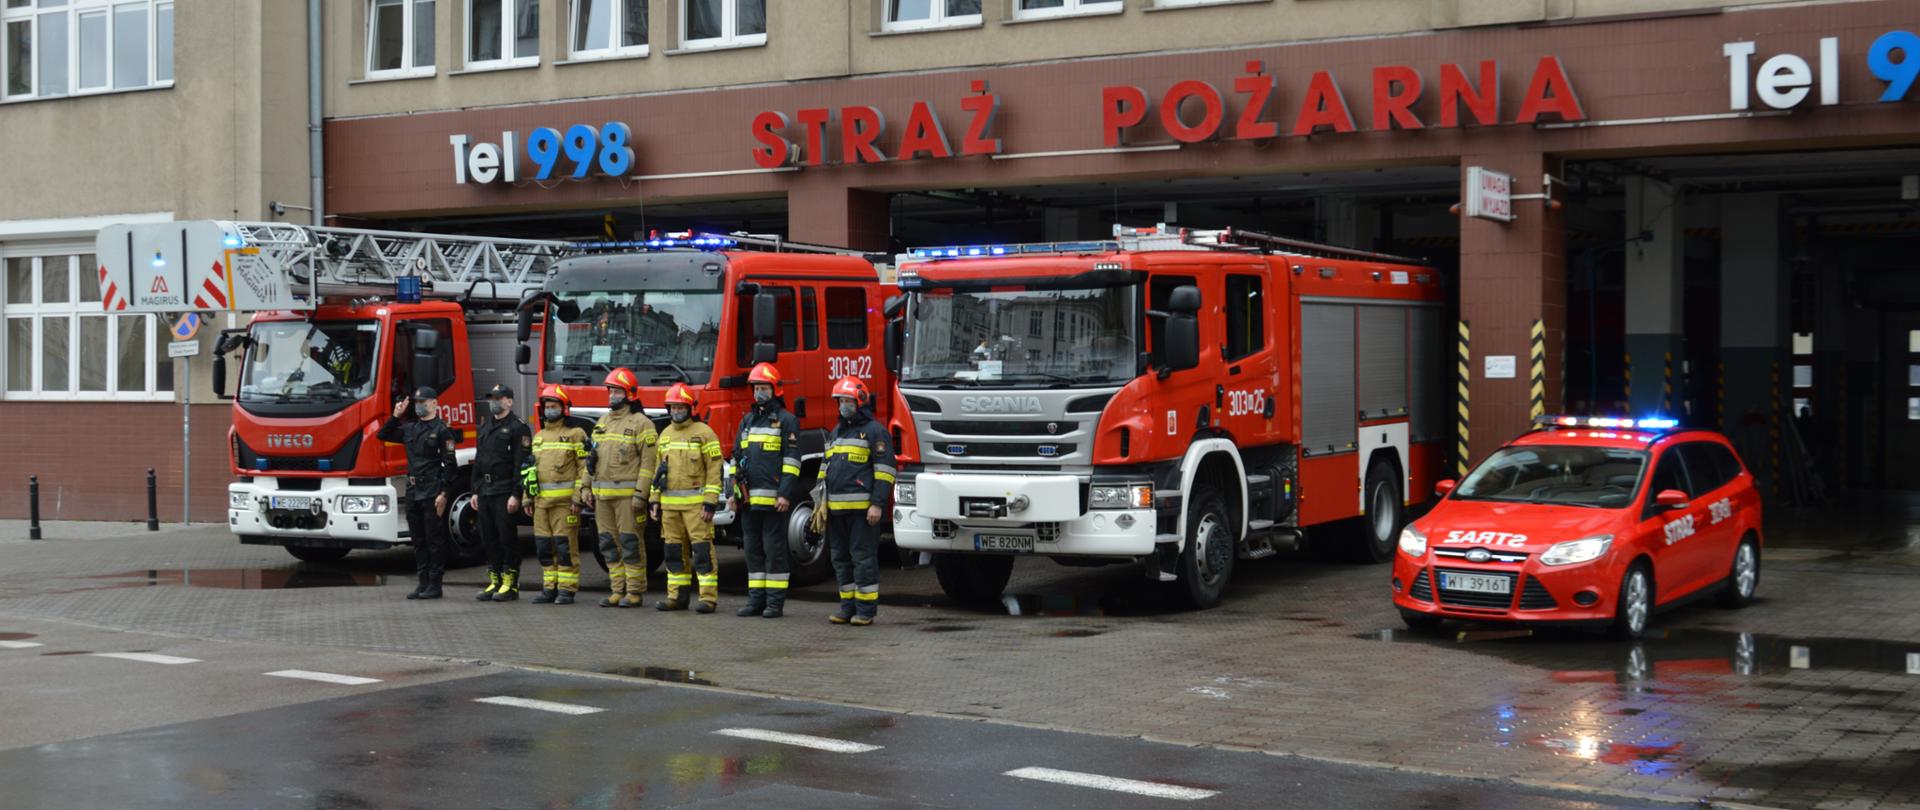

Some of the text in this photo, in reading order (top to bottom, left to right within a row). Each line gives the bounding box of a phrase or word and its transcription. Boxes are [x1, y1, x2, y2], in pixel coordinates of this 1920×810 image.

[1723, 37, 1839, 110] Tel
[752, 55, 1585, 168] STRAŻ POŻARNA
[450, 121, 635, 184] Tel 998
[141, 296, 179, 305] MAGIRUS
[828, 355, 850, 380] 303
[858, 355, 872, 378] 22
[459, 402, 473, 424] 51
[960, 396, 1042, 412] SCANIA
[1228, 390, 1248, 416] 303
[267, 433, 313, 448] IVECO
[981, 535, 1032, 549] WE 820NM
[1448, 575, 1507, 591] WI 3916T
